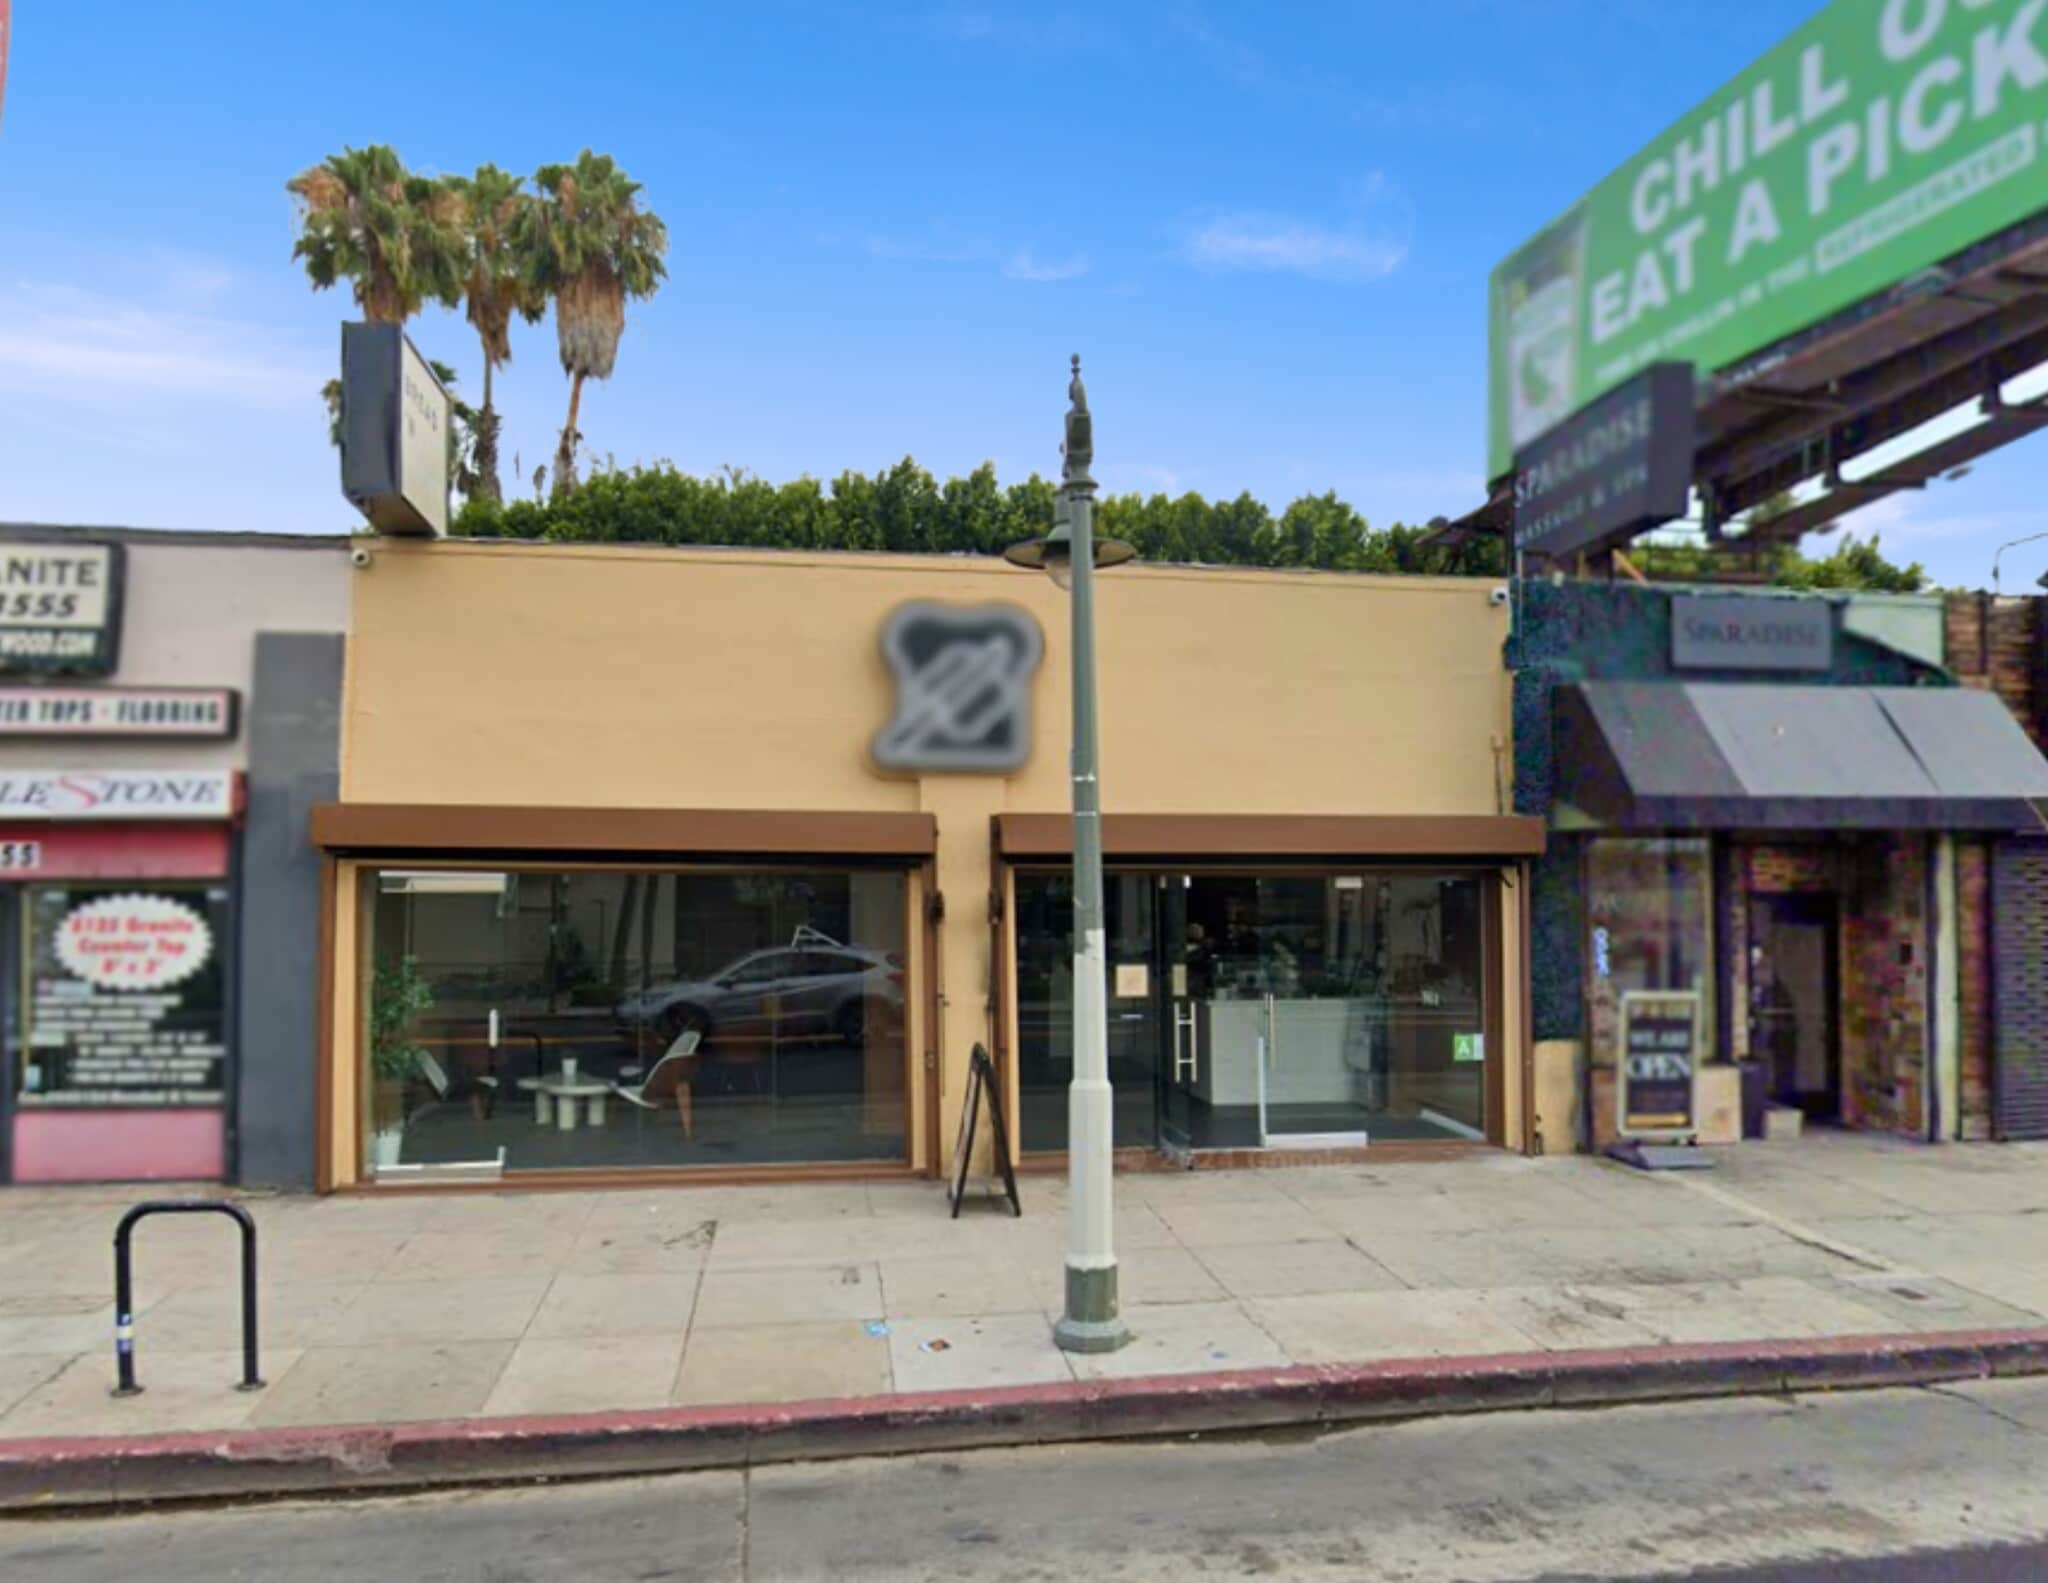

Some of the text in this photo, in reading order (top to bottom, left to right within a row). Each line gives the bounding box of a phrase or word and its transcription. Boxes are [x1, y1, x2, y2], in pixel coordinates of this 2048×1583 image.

[1631, 0, 2001, 234] CHILL O
[1591, 216, 1706, 344] EAT
[1726, 178, 1781, 266] A
[0, 558, 98, 587] NITE
[39, 700, 92, 722] TOPS
[117, 701, 219, 724] FLOORING
[1457, 1039, 1471, 1057] A
[1626, 1053, 1692, 1079] OPEN
